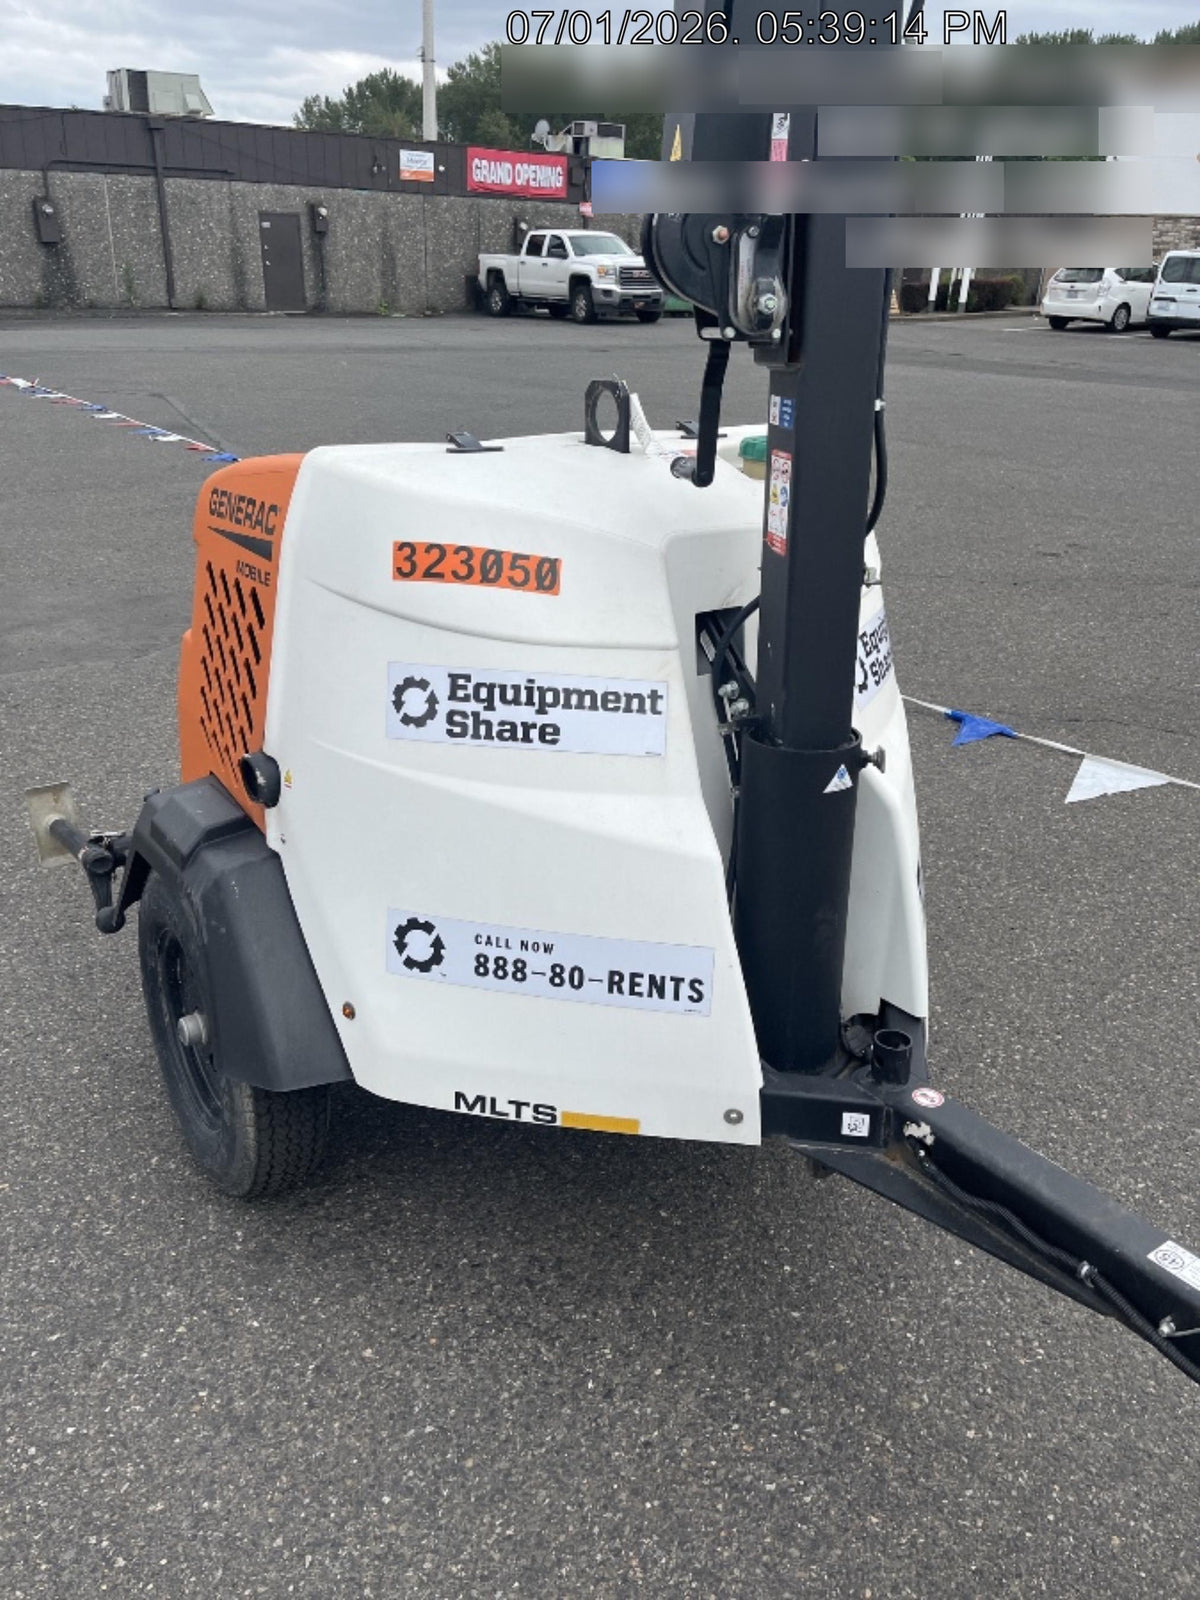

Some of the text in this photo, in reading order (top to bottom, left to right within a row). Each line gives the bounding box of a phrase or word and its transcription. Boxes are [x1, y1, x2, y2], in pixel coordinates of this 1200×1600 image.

[472, 157, 563, 189] GRAND OPENING
[209, 487, 278, 536] GENERAC
[235, 559, 271, 587] MOBILE
[396, 541, 560, 592] 323050
[447, 673, 664, 715] Equipment
[446, 709, 561, 746] Share
[474, 933, 554, 956] CALL NOW
[474, 953, 705, 1004] 888-80-RENTS
[454, 1090, 558, 1124] MLTS
